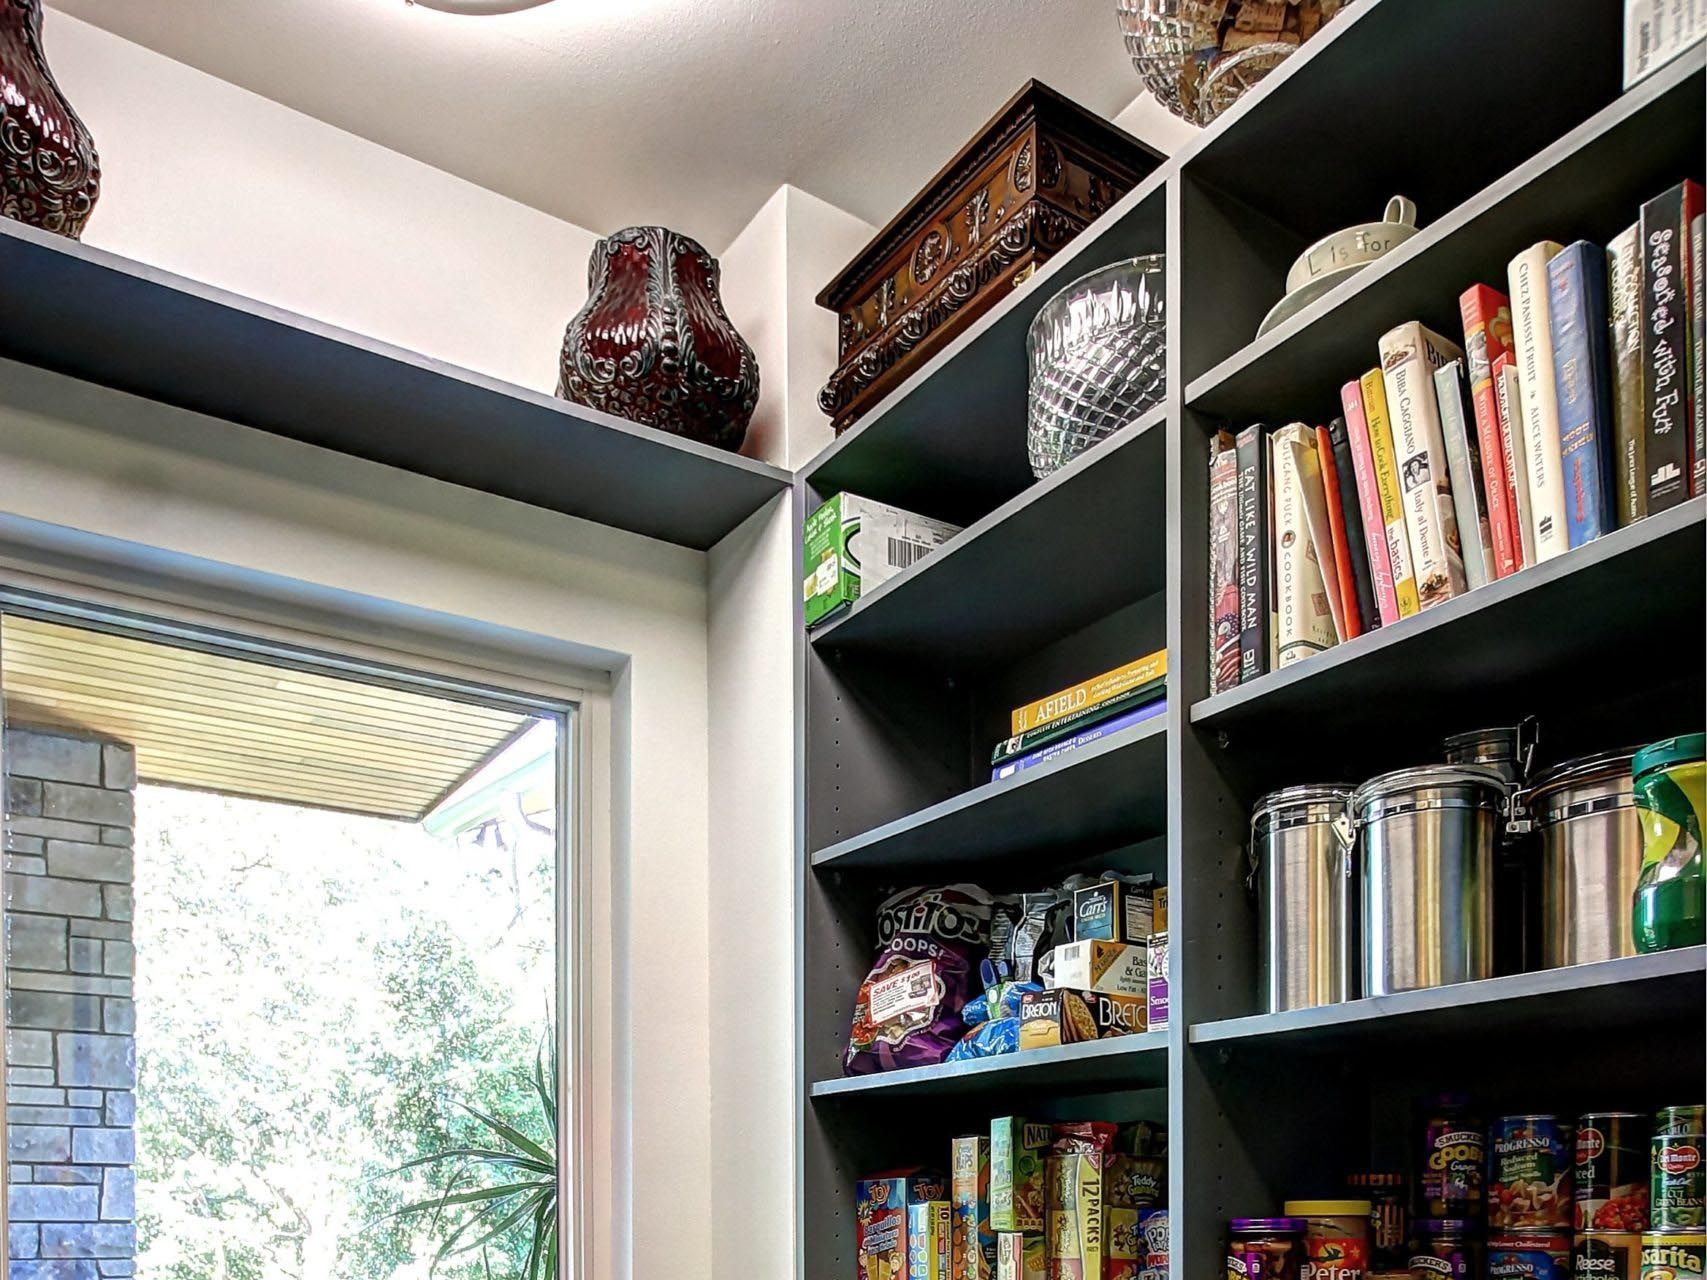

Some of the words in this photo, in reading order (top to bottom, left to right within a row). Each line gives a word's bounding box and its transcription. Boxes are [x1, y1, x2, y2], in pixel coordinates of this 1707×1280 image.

[1330, 245, 1348, 264] is
[1362, 231, 1390, 253] for
[1518, 262, 1529, 298] CHEZ
[1648, 228, 1677, 335] Seasoned
[1521, 296, 1534, 345] PANISSE
[1525, 345, 1537, 383] FRUIT
[1395, 367, 1407, 397] BIBA
[1399, 396, 1416, 455] CAGGIANO
[1530, 406, 1541, 440] ALICE
[1244, 465, 1256, 492] EAT
[1533, 440, 1546, 489] WATERS
[1244, 498, 1256, 530] LIKE
[1283, 497, 1293, 526] PUCK
[1413, 489, 1425, 513] Italy
[1419, 525, 1431, 558] Dente
[1245, 534, 1256, 546] A
[1246, 547, 1257, 587] WILD
[1389, 538, 1404, 581] basics
[1283, 552, 1294, 637] COOKBOOK
[1246, 592, 1258, 630] MAN
[1034, 687, 1087, 723] AFIELD
[875, 899, 982, 944] OSTITOS
[1079, 897, 1108, 918] Carr's
[884, 937, 945, 961] OOPS!
[1132, 956, 1147, 967] Bas
[873, 979, 898, 997] SAVE
[1150, 996, 1168, 1007] Smo
[1022, 1001, 1059, 1020] BRETON
[1100, 996, 1148, 1029] BRETO
[1435, 1131, 1484, 1149] SMUCKE
[1494, 1136, 1550, 1153] PROGRESSO
[1430, 1144, 1484, 1170] GOOB
[1500, 1152, 1538, 1166] Reduced
[1670, 1153, 1697, 1162] Monte
[1131, 1173, 1157, 1188] Teddy
[1576, 1164, 1596, 1179] iced
[1081, 1179, 1100, 1198] 12
[1086, 1198, 1100, 1248] PACKS
[1515, 1239, 1551, 1249] Cholesterol
[1490, 1263, 1534, 1275] PROGRESSO
[1575, 1253, 1616, 1271] Reese
[1641, 1246, 1703, 1274] sarita
